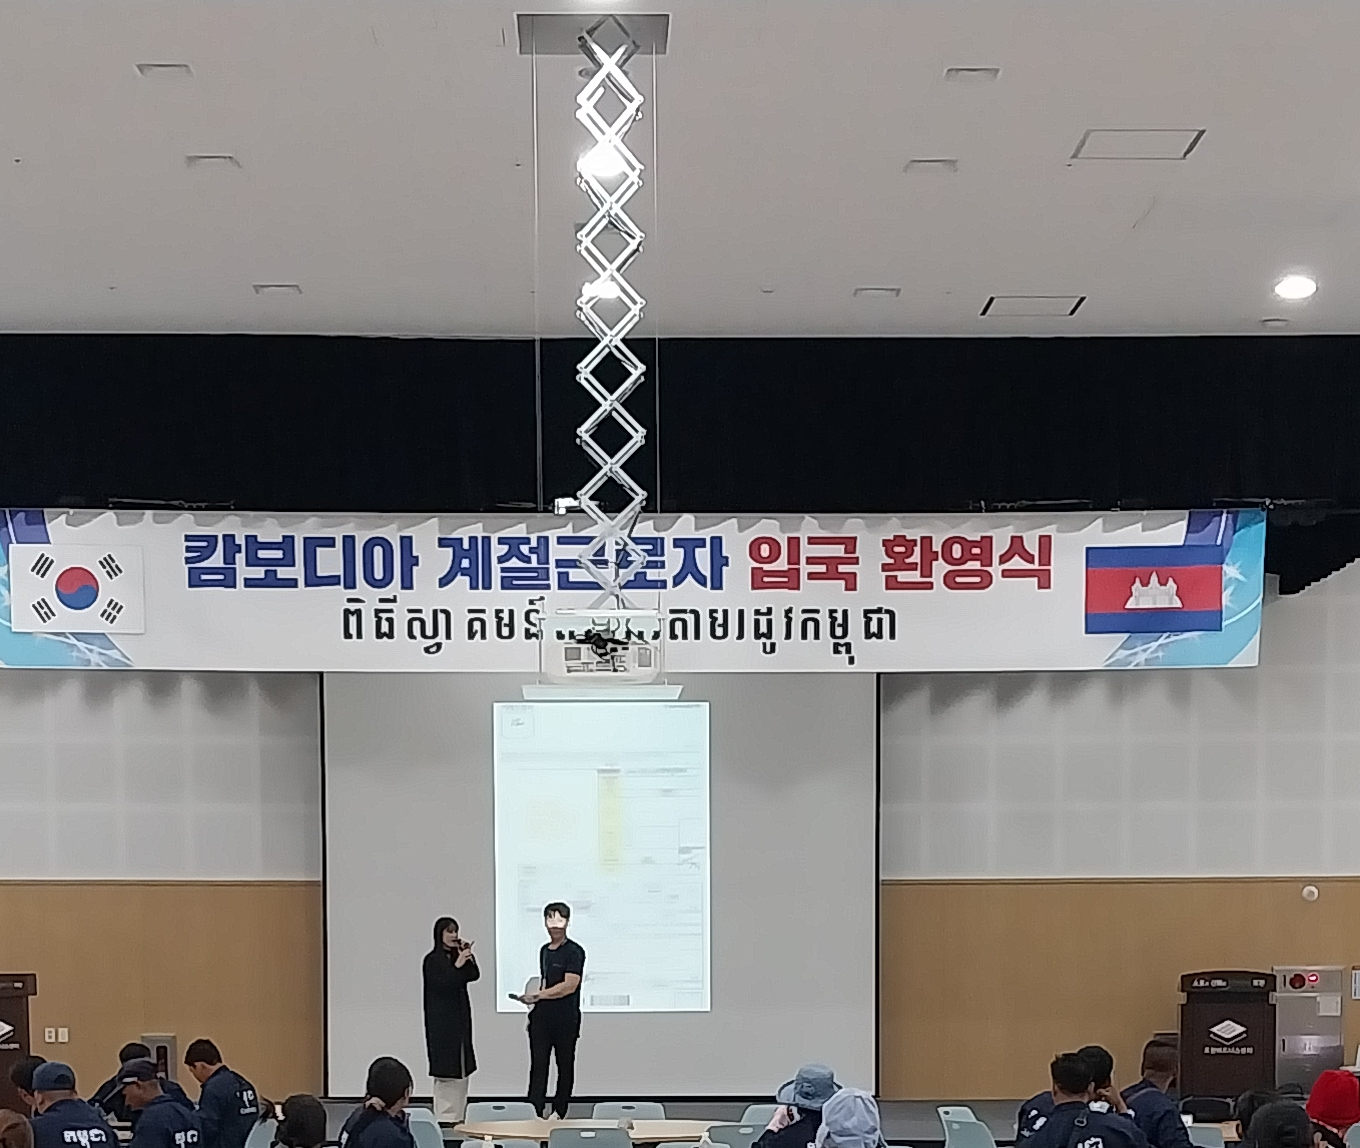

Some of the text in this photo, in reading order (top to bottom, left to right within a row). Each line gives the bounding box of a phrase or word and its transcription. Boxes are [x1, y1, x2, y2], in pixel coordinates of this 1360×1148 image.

[184, 534, 1054, 591] 캄보디아 계절근로자 입국 환영식
